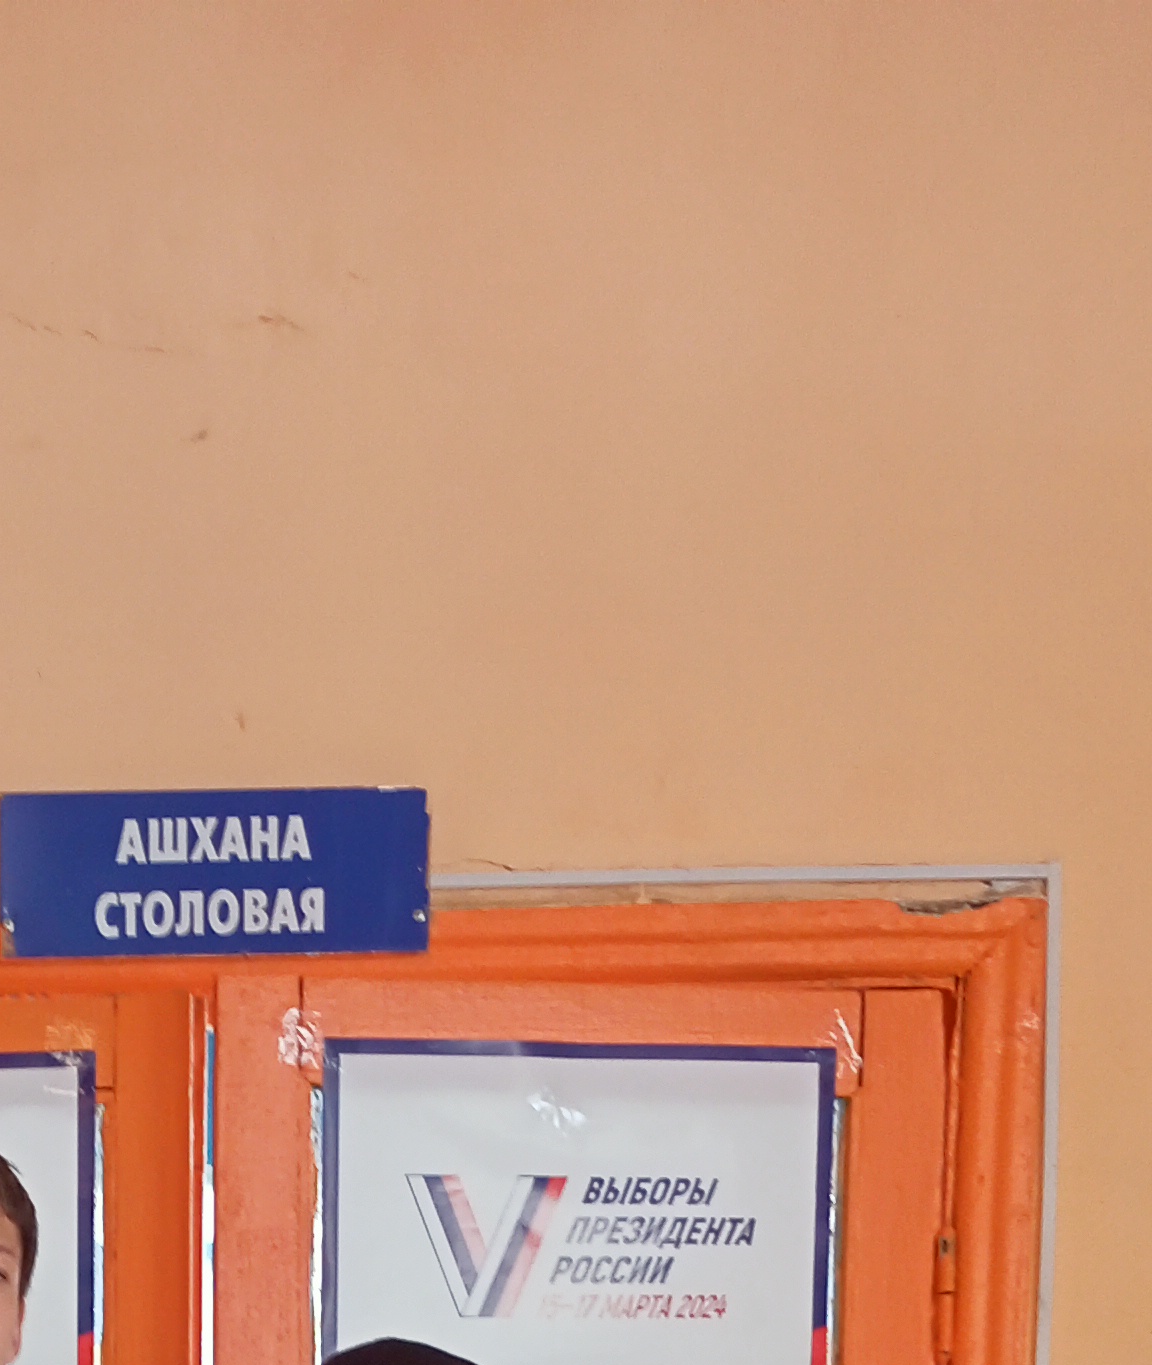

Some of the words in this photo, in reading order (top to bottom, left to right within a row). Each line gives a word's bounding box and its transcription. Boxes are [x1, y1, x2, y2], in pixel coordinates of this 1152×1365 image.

[115, 814, 313, 865] АШХАНА
[94, 887, 326, 940] СТОЛОВАЯ
[581, 1176, 719, 1206] ВЫБОРЫ
[565, 1215, 757, 1249] ПРЕЗИДЕНТА
[549, 1255, 675, 1285] РОССИИ
[602, 1294, 674, 1319] МАРТА
[675, 1294, 728, 1319] 2024
